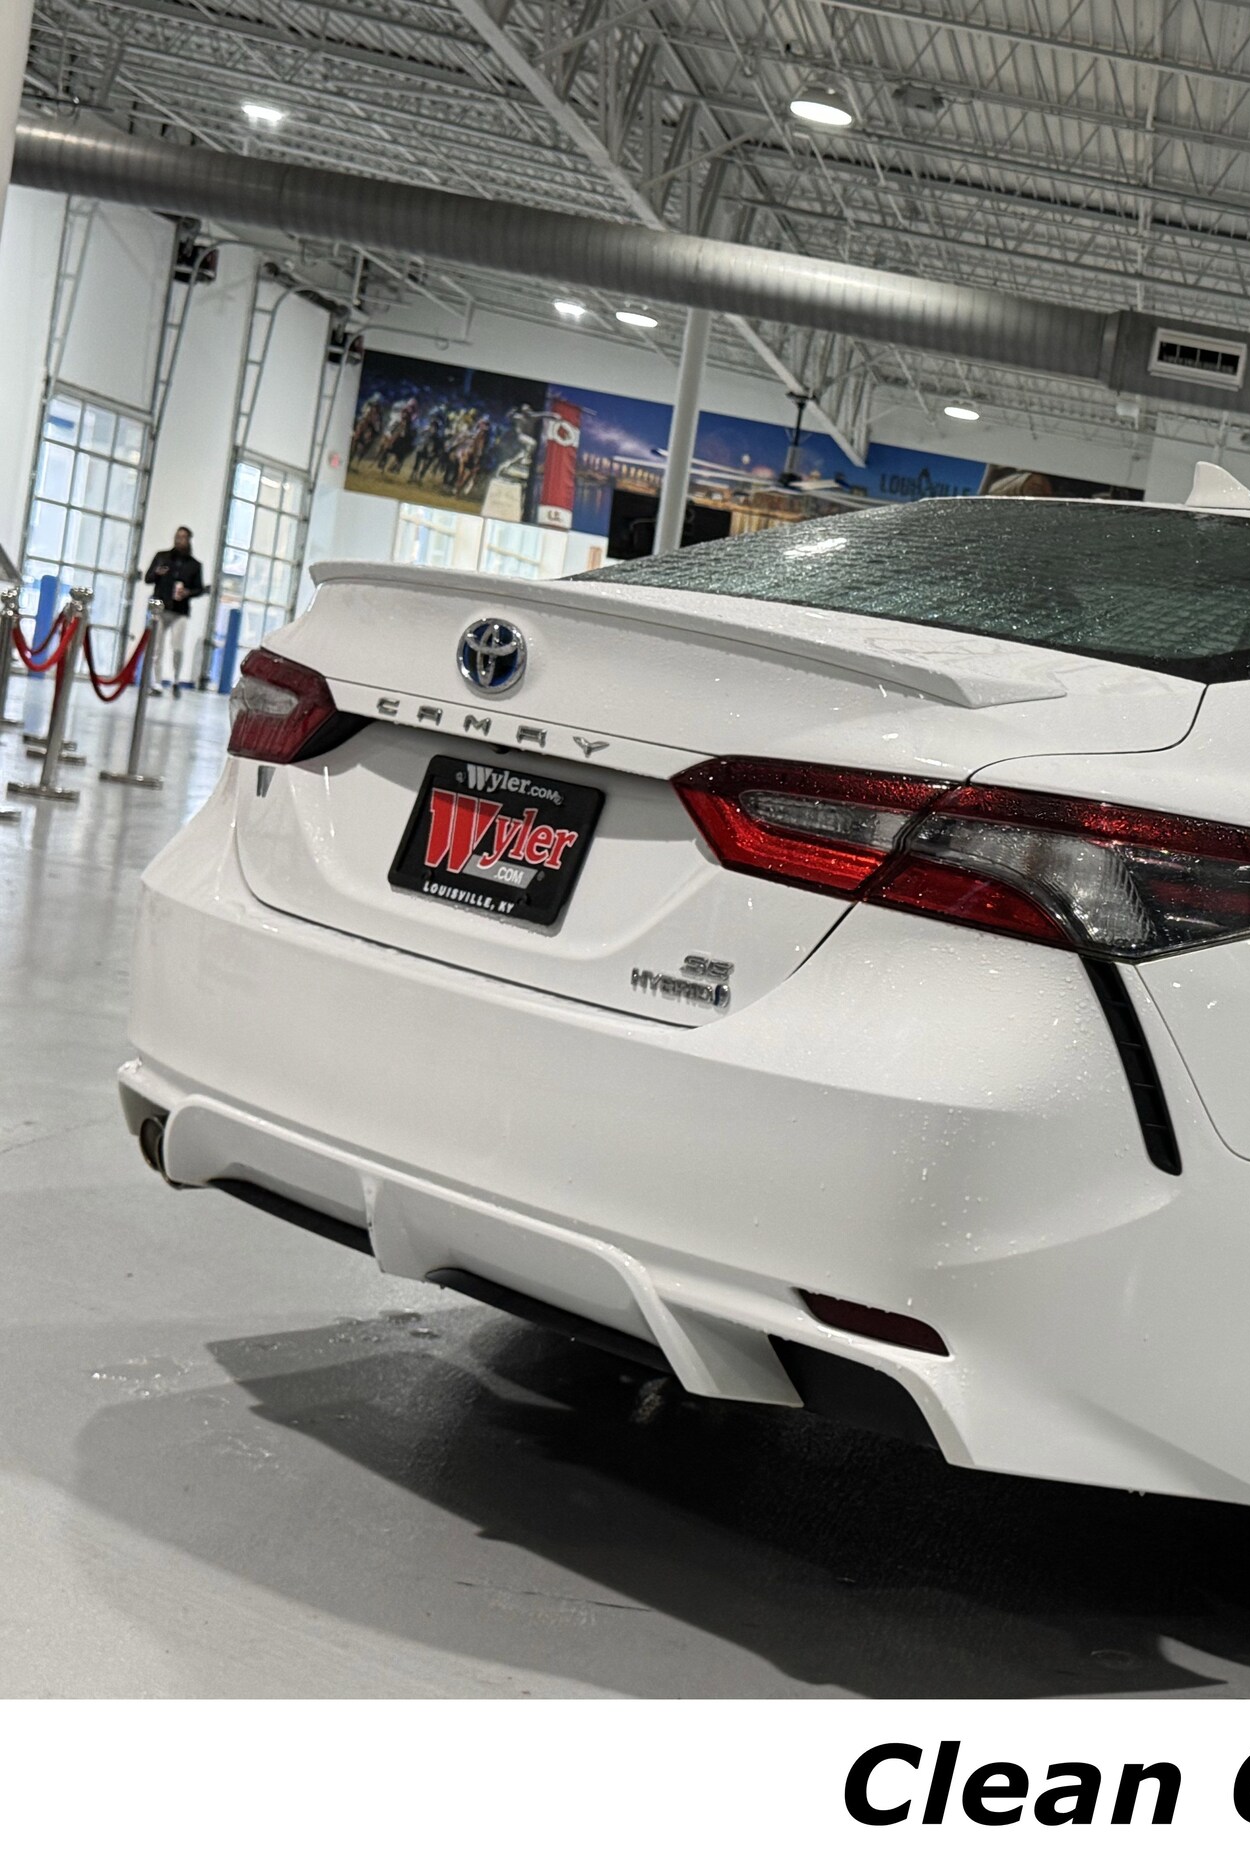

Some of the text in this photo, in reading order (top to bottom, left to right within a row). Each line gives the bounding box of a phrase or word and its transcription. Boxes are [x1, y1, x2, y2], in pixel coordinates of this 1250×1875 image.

[376, 697, 610, 758] CAMRY
[424, 787, 578, 874] Wyler
[422, 881, 515, 914] LOUISVILLE, KY
[681, 955, 734, 981] SE
